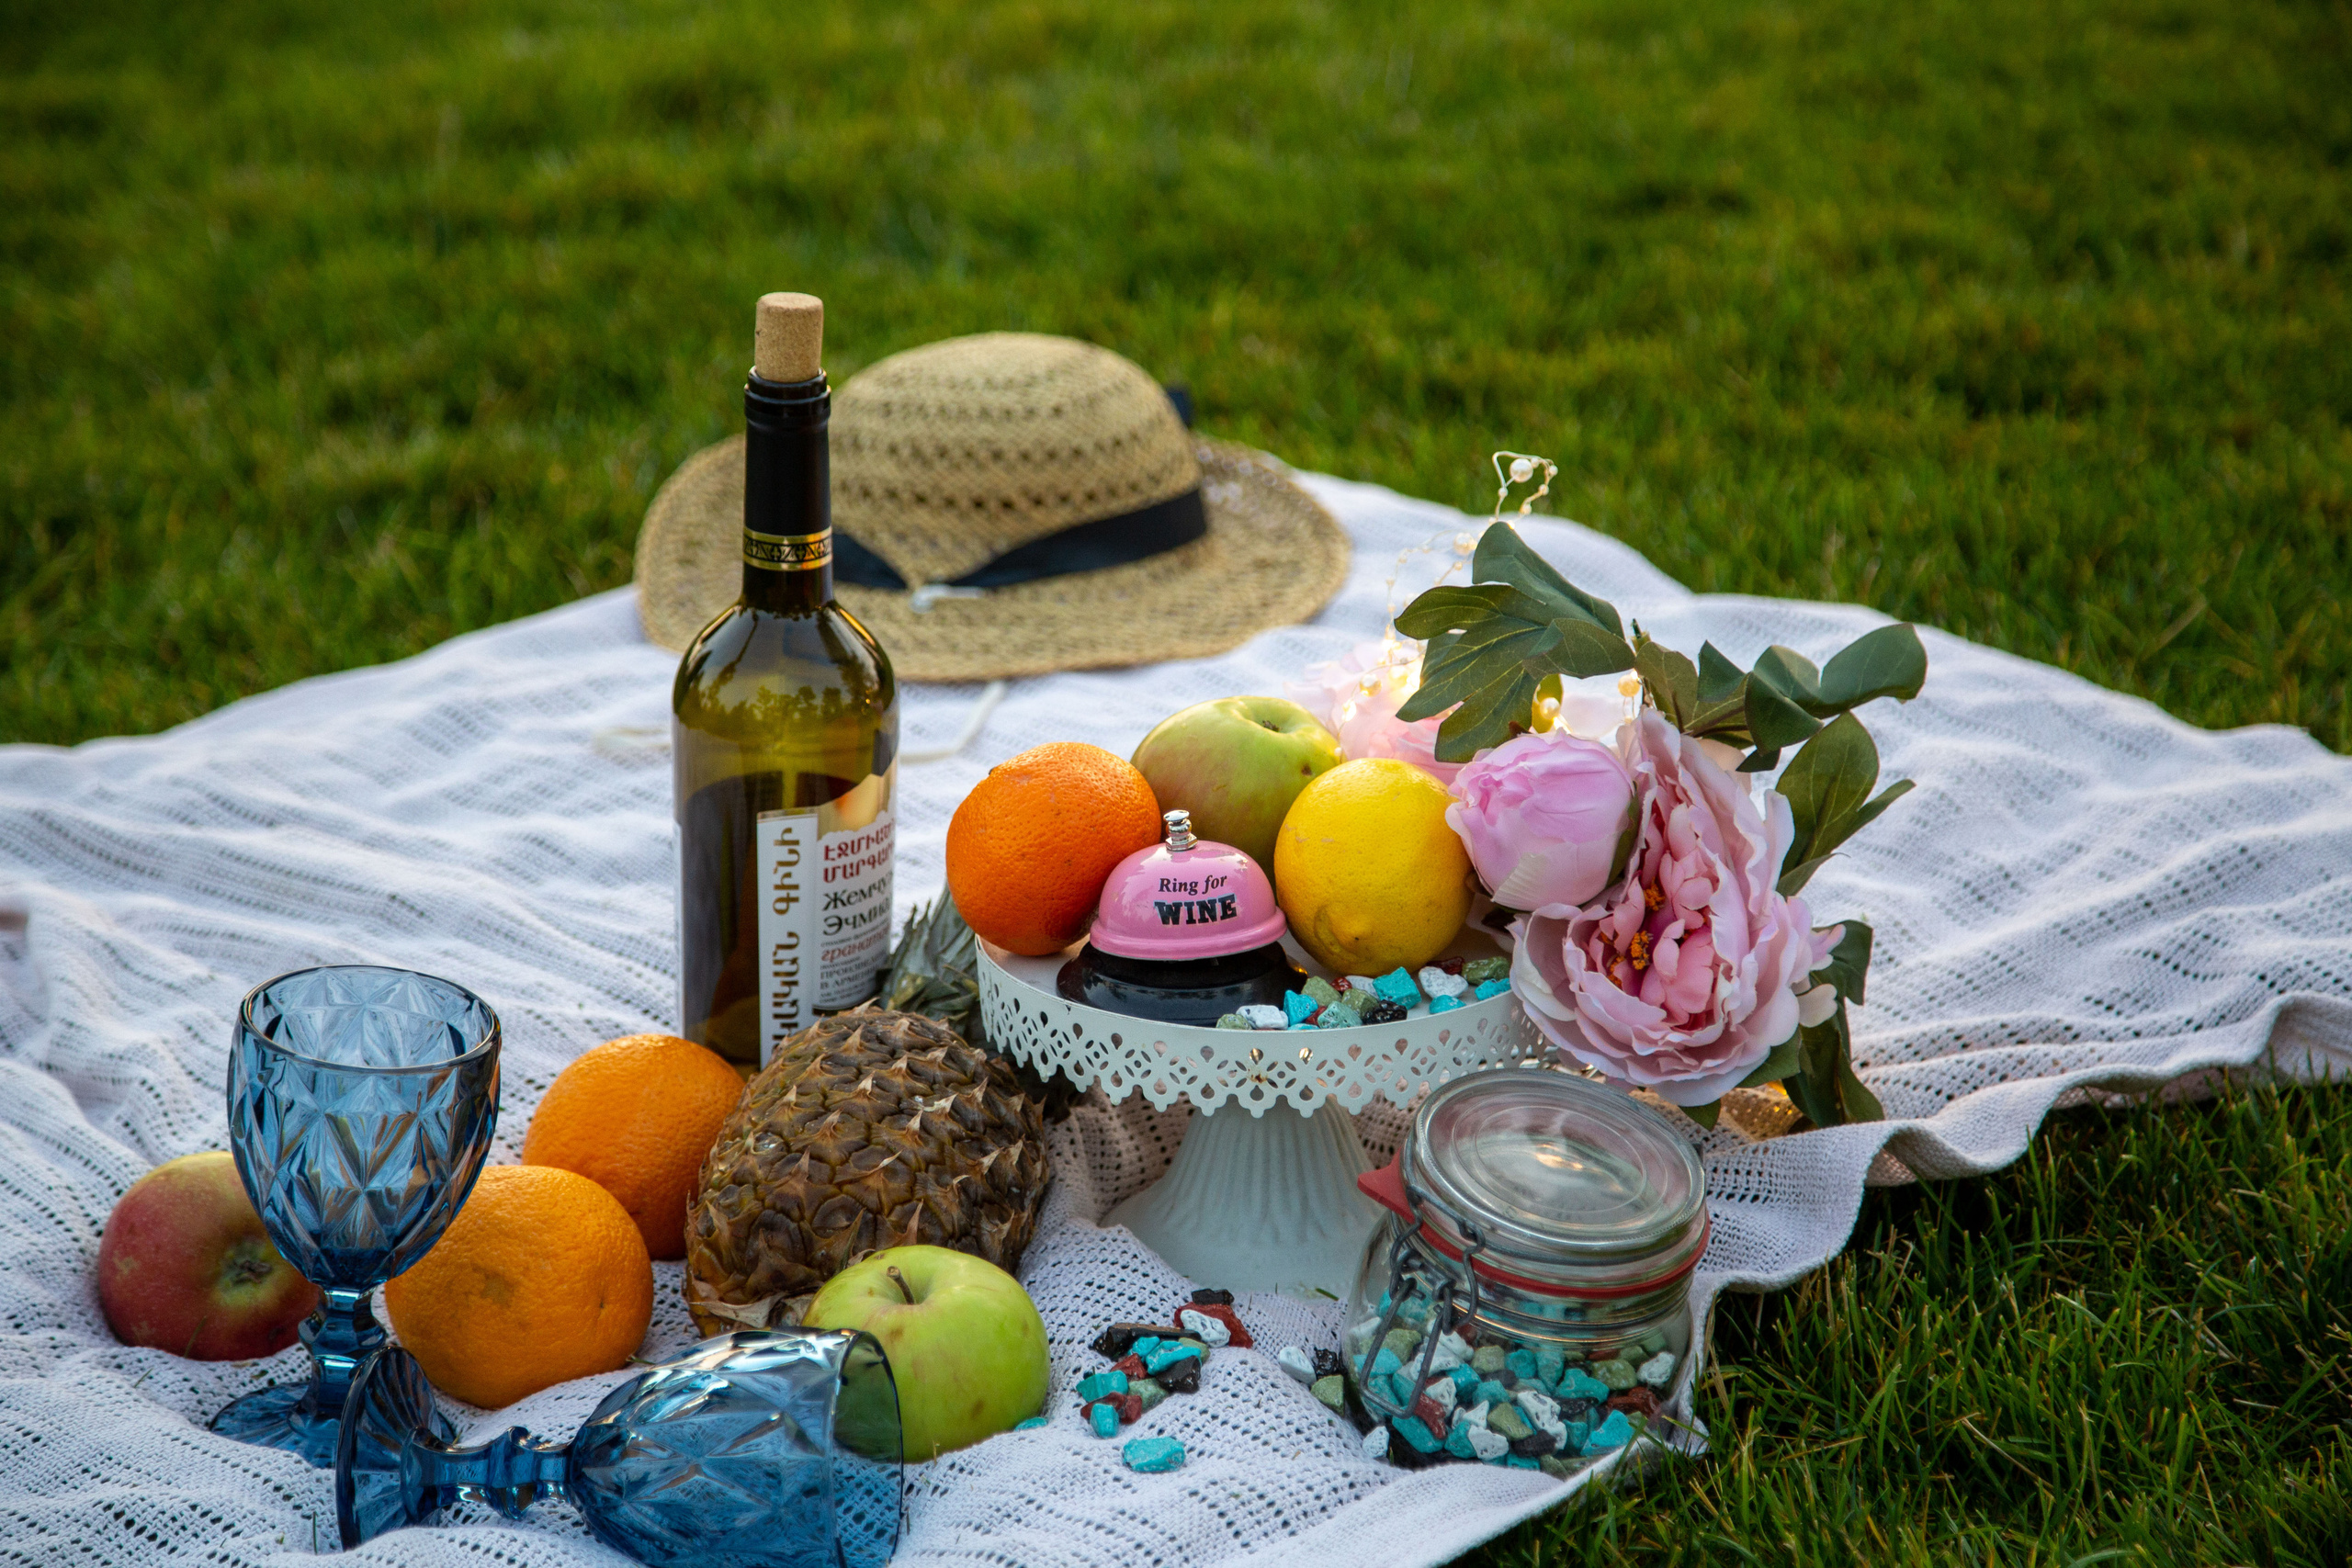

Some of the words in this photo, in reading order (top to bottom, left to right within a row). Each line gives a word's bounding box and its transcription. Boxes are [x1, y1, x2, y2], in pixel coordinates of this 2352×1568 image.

[772, 827, 800, 916] ԳԻՆԻ
[1158, 877, 1199, 896] Ring
[1201, 874, 1227, 895] for
[1153, 893, 1238, 926] WINE
[772, 931, 799, 1057] ԿԱԿԱՆ
